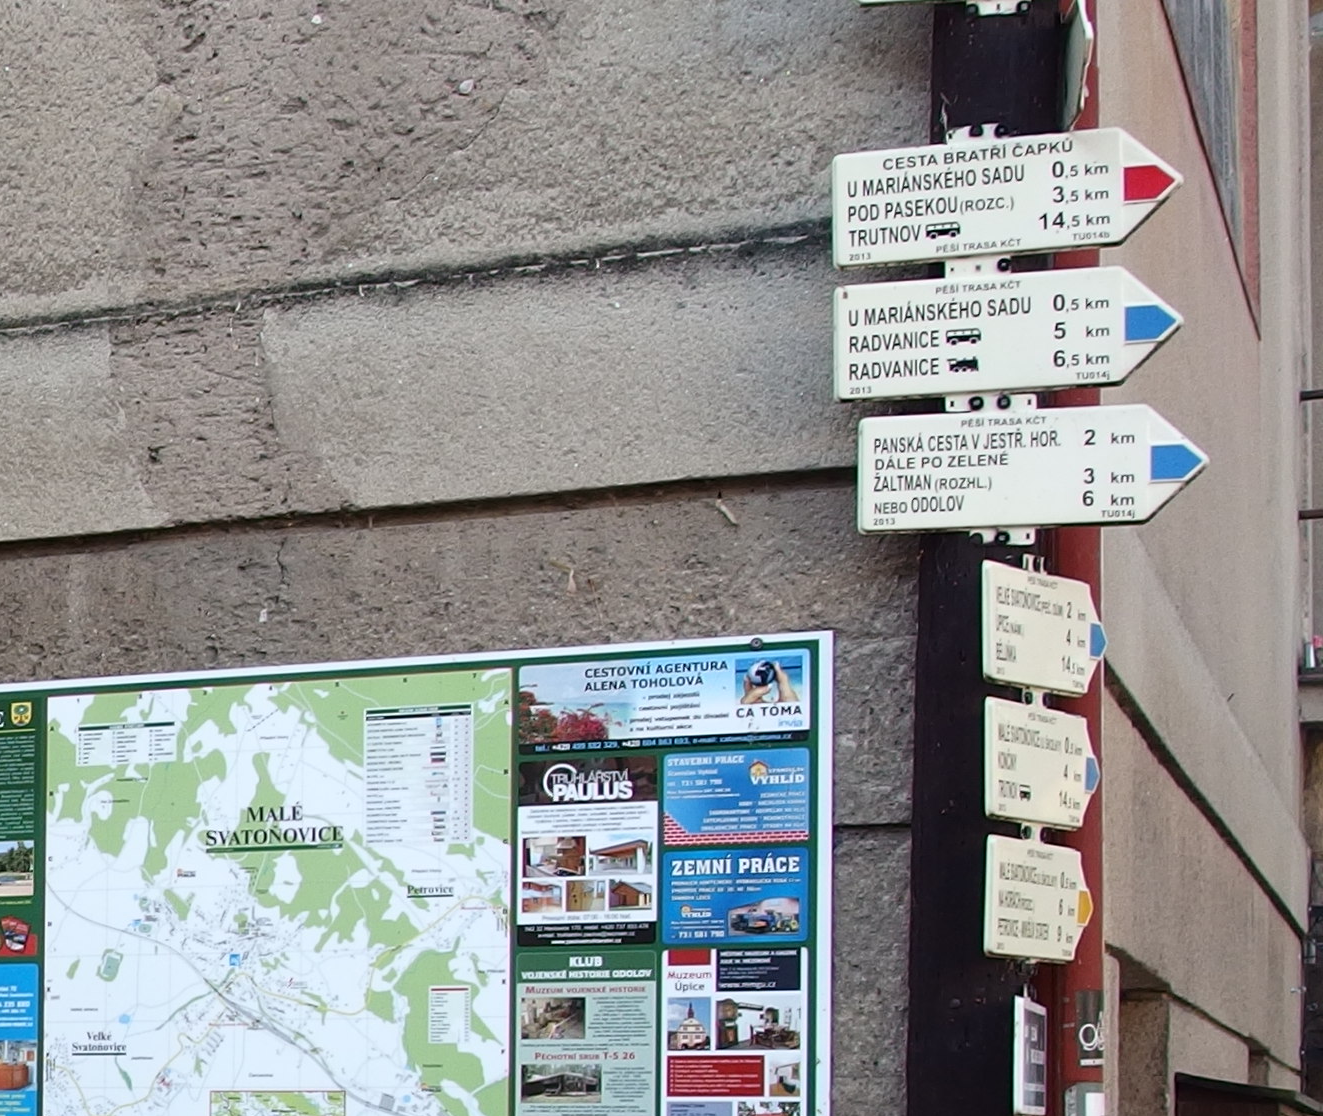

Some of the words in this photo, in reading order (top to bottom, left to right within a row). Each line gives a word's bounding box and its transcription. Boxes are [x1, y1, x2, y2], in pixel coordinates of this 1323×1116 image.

[883, 154, 938, 171] CESTA
[944, 145, 1007, 164] BRATŘÍ
[1012, 138, 1073, 157] ČAPKŮ
[1052, 162, 1079, 178] 0,5
[1084, 164, 1109, 175] km
[847, 181, 857, 198] U
[862, 167, 977, 197] MARIÁNSKÉHO
[981, 164, 1024, 185] SADU
[1052, 186, 1079, 203] 3,5
[1085, 189, 1109, 201] km
[848, 204, 879, 223] POD
[884, 196, 958, 219] PASEKOU
[1038, 211, 1080, 231] 14,5
[1086, 214, 1111, 226] km
[849, 224, 921, 247] TRUTNOV
[936, 243, 959, 253] PĚŠÍ
[963, 240, 997, 251] TRASA
[1001, 237, 1021, 248] KČT
[849, 252, 871, 261] 2013
[935, 284, 959, 295] PĚŠÍ
[962, 282, 997, 293] TRASA
[1000, 280, 1021, 290] KČT
[848, 310, 858, 327] U
[864, 298, 982, 326] MARIÁNSKÉHO
[987, 296, 1032, 317] SADU
[1053, 294, 1080, 312] 0,5
[1085, 297, 1109, 310] km
[1054, 322, 1066, 339] 5
[1085, 326, 1110, 338] km
[849, 330, 940, 353] RADVANICE
[1053, 349, 1080, 368] 6,5
[1085, 353, 1110, 365] km
[849, 357, 940, 381] RADVANICE
[850, 386, 872, 395] 2013
[961, 418, 985, 428] PĚŠÍ
[988, 417, 1022, 427] TRASA
[1026, 416, 1047, 425] KČT
[874, 432, 925, 454] PANSKÁ
[928, 436, 967, 452] CESTA
[971, 435, 980, 450] V
[983, 428, 1027, 450] JESTŘ.
[1030, 430, 1061, 447] HOR.
[1084, 430, 1096, 446] 2
[1111, 432, 1135, 444] km
[875, 455, 915, 470] DÁLE
[921, 457, 943, 469] PO
[948, 450, 1009, 467] ZELENÉ
[873, 472, 932, 492] ŽALTMAN
[934, 476, 992, 491] (ROZHL.)
[1084, 468, 1095, 484] 3
[1111, 472, 1135, 483] km
[874, 501, 908, 514] NEBO
[910, 495, 964, 513] ODOLOV
[1082, 490, 1094, 507] 6
[1111, 494, 1135, 506] km
[873, 517, 895, 526] 2013
[1066, 602, 1072, 618] 2
[1078, 610, 1086, 620] km
[1066, 630, 1071, 645] 4
[1077, 638, 1086, 648] km
[585, 663, 651, 679] CESTOVNÍ
[656, 661, 728, 674] AGENTURA
[585, 680, 627, 692] ALENA
[632, 673, 704, 689] TOHOLOVÁ
[736, 707, 754, 718] CA
[551, 768, 628, 784] TRUHLÁŘSTVÍ
[750, 772, 805, 785] VYHLÍD
[1063, 765, 1068, 780] 4
[553, 781, 633, 802] PAULUS
[246, 802, 303, 823] MALÉ
[205, 825, 344, 846] SVATOŇOVICE
[671, 854, 731, 876] ZEMNÍ
[738, 853, 800, 874] PRÁCE
[407, 884, 454, 895] Petrovice
[569, 956, 603, 967] KLUB
[613, 969, 652, 977] ODOLOV
[667, 971, 712, 979] Muzeum
[675, 981, 705, 992] Úpice
[87, 1032, 112, 1041] Velké
[72, 1043, 126, 1052] Svatoňovice
